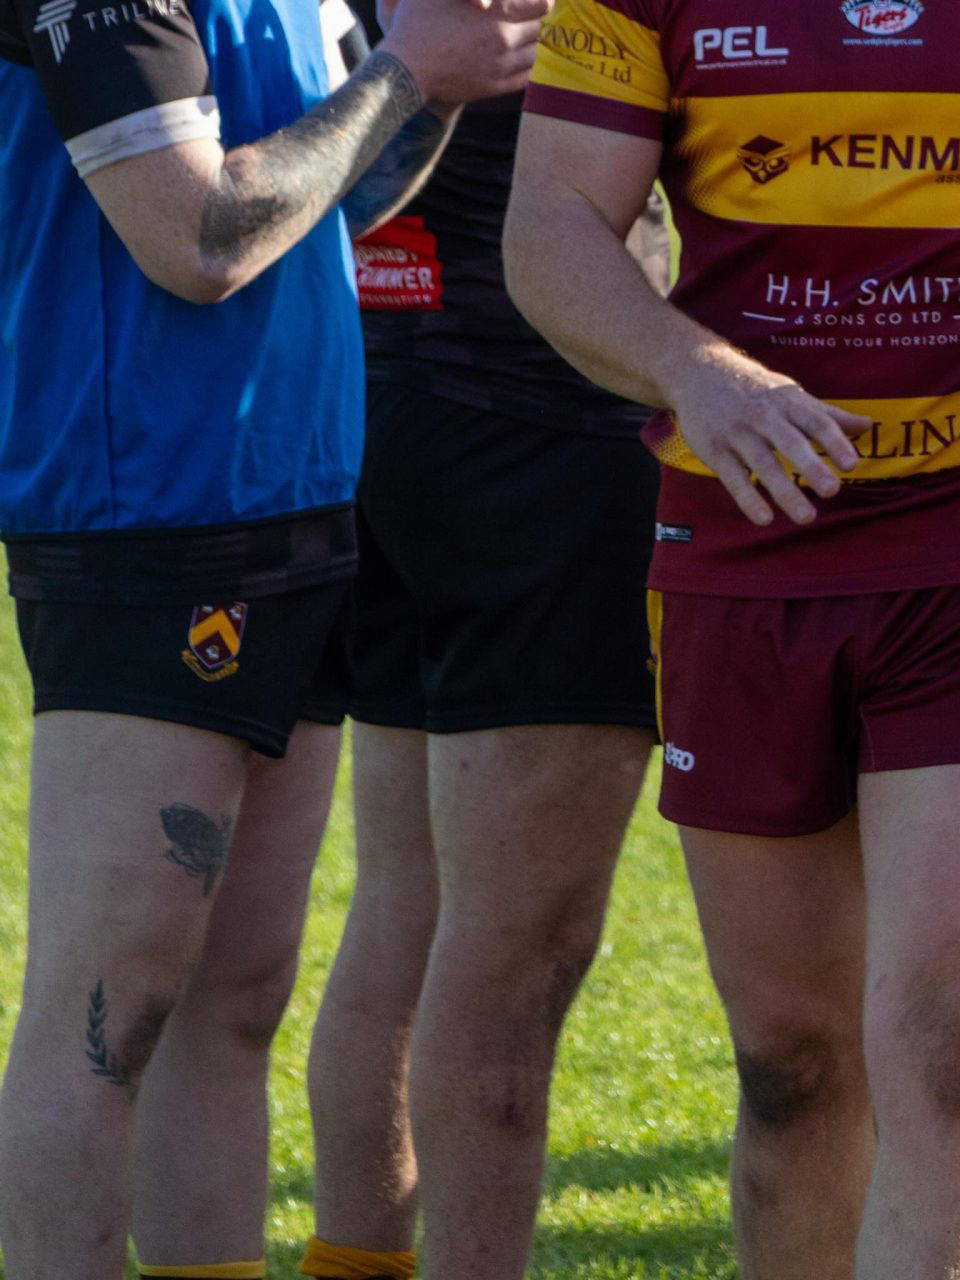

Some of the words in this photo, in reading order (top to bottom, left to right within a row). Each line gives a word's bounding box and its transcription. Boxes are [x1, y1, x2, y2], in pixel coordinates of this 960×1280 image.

[693, 24, 789, 62] PEL
[600, 61, 631, 83] Ltd
[766, 274, 839, 309] H.H.
[811, 312, 866, 327] SONS
[874, 311, 901, 326] CO
[911, 311, 942, 325] LTD
[769, 334, 837, 348] BUILDING
[843, 336, 883, 348] YOUR
